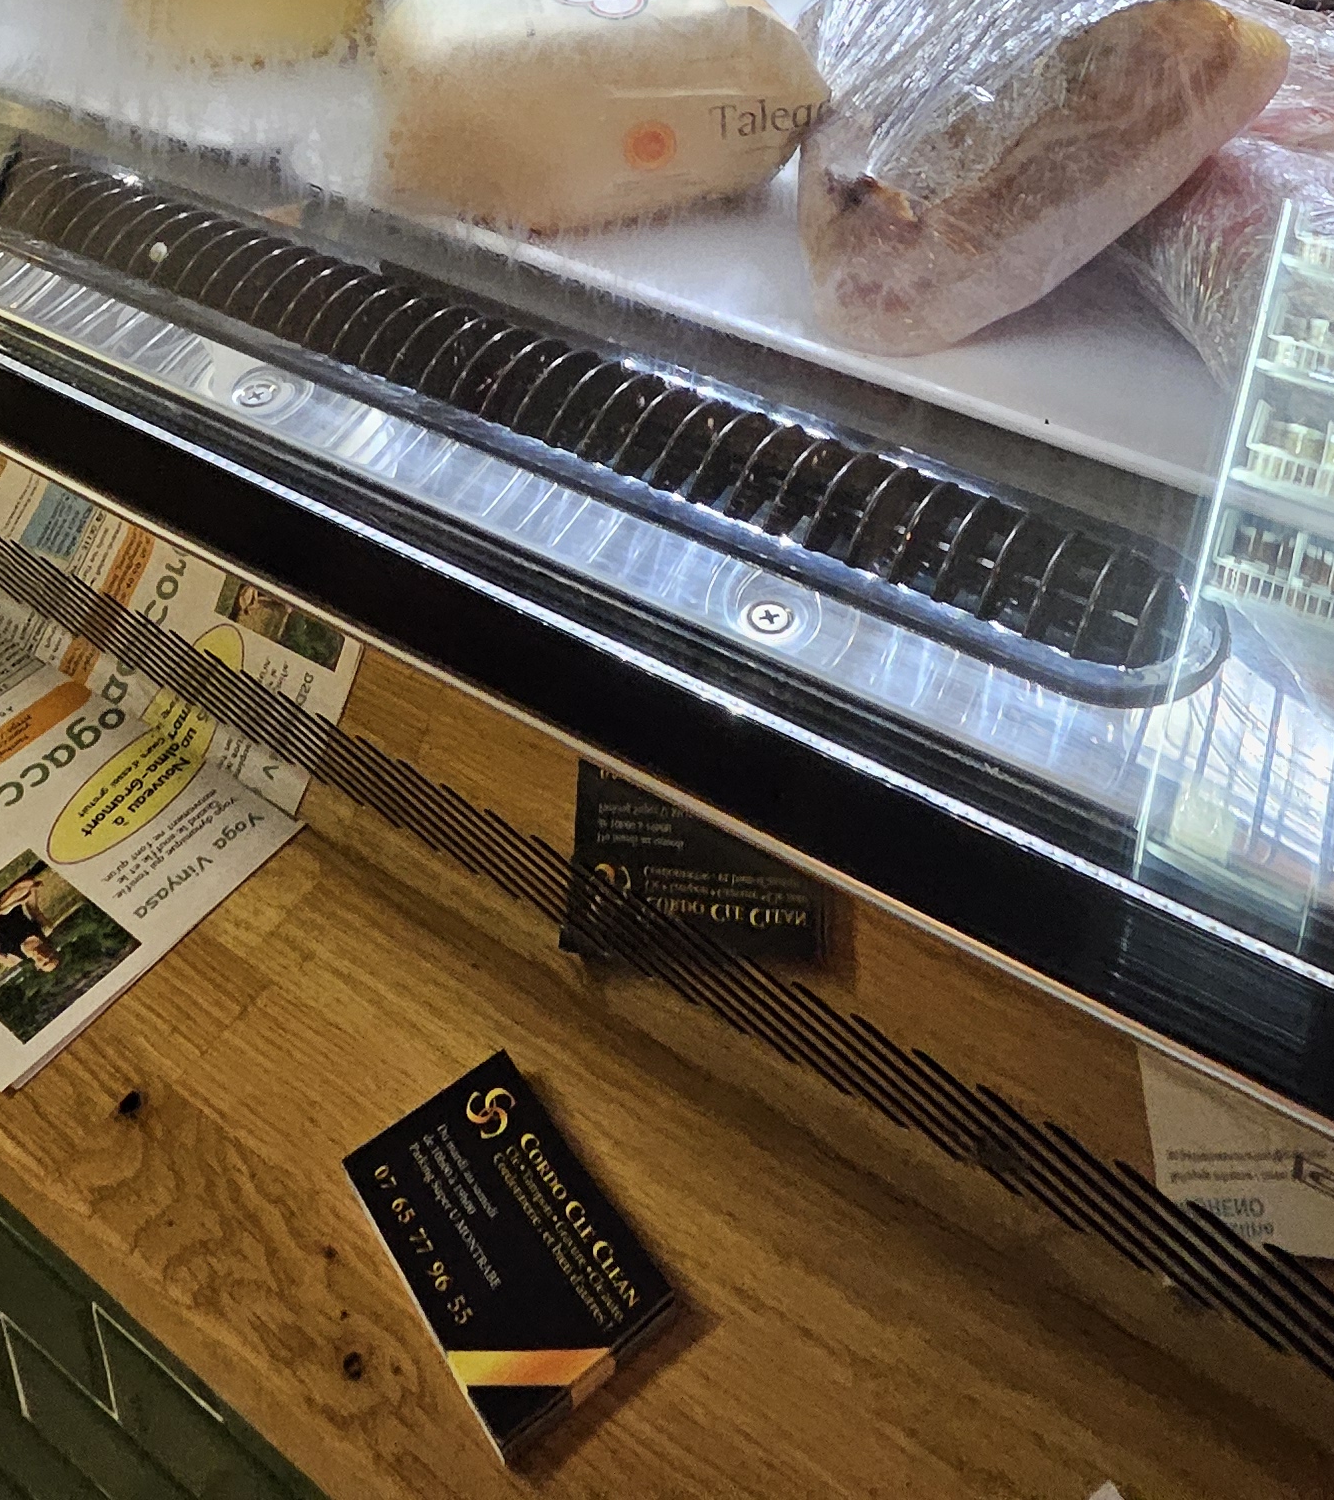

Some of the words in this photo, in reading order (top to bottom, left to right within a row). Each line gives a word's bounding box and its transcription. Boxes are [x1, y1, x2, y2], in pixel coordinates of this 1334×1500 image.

[82, 742, 185, 836] alma-Gramont
[127, 756, 191, 812] Nouveau
[212, 812, 265, 849] Yoga
[134, 856, 212, 918] Vinyasa
[391, 1197, 415, 1223] 65
[409, 1227, 434, 1253] 77
[428, 1261, 449, 1291] 96
[447, 1295, 473, 1324] 55
